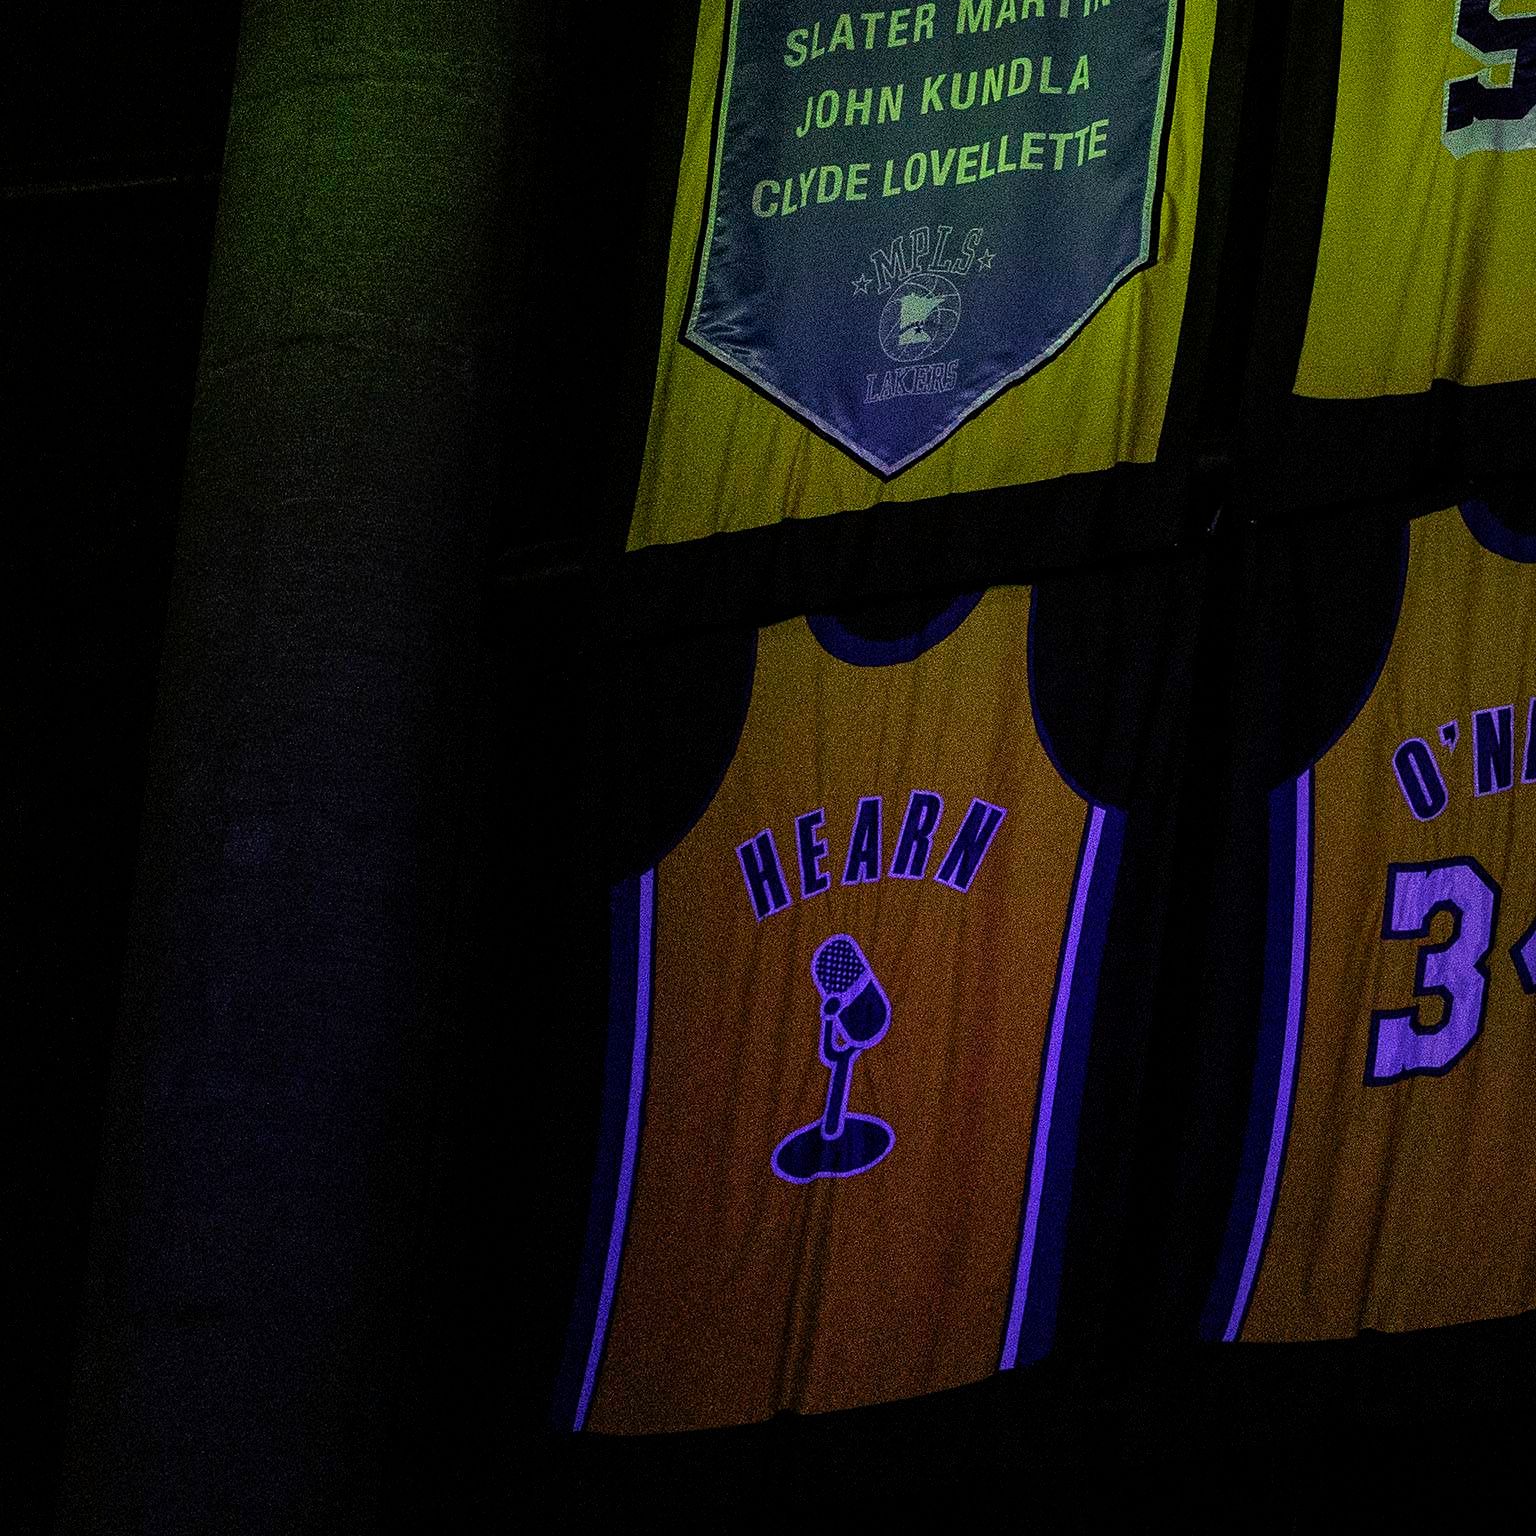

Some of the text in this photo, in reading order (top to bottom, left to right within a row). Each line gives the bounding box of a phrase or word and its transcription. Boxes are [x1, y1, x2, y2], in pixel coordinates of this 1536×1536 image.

[783, 3, 936, 67] SLATER
[797, 55, 1089, 138] JOHN KUNDLA
[751, 118, 1110, 219] CLYDE LOVELLETTE
[871, 225, 983, 294] MPLS
[863, 359, 959, 404] LAKERS
[735, 788, 1008, 924] HEARN
